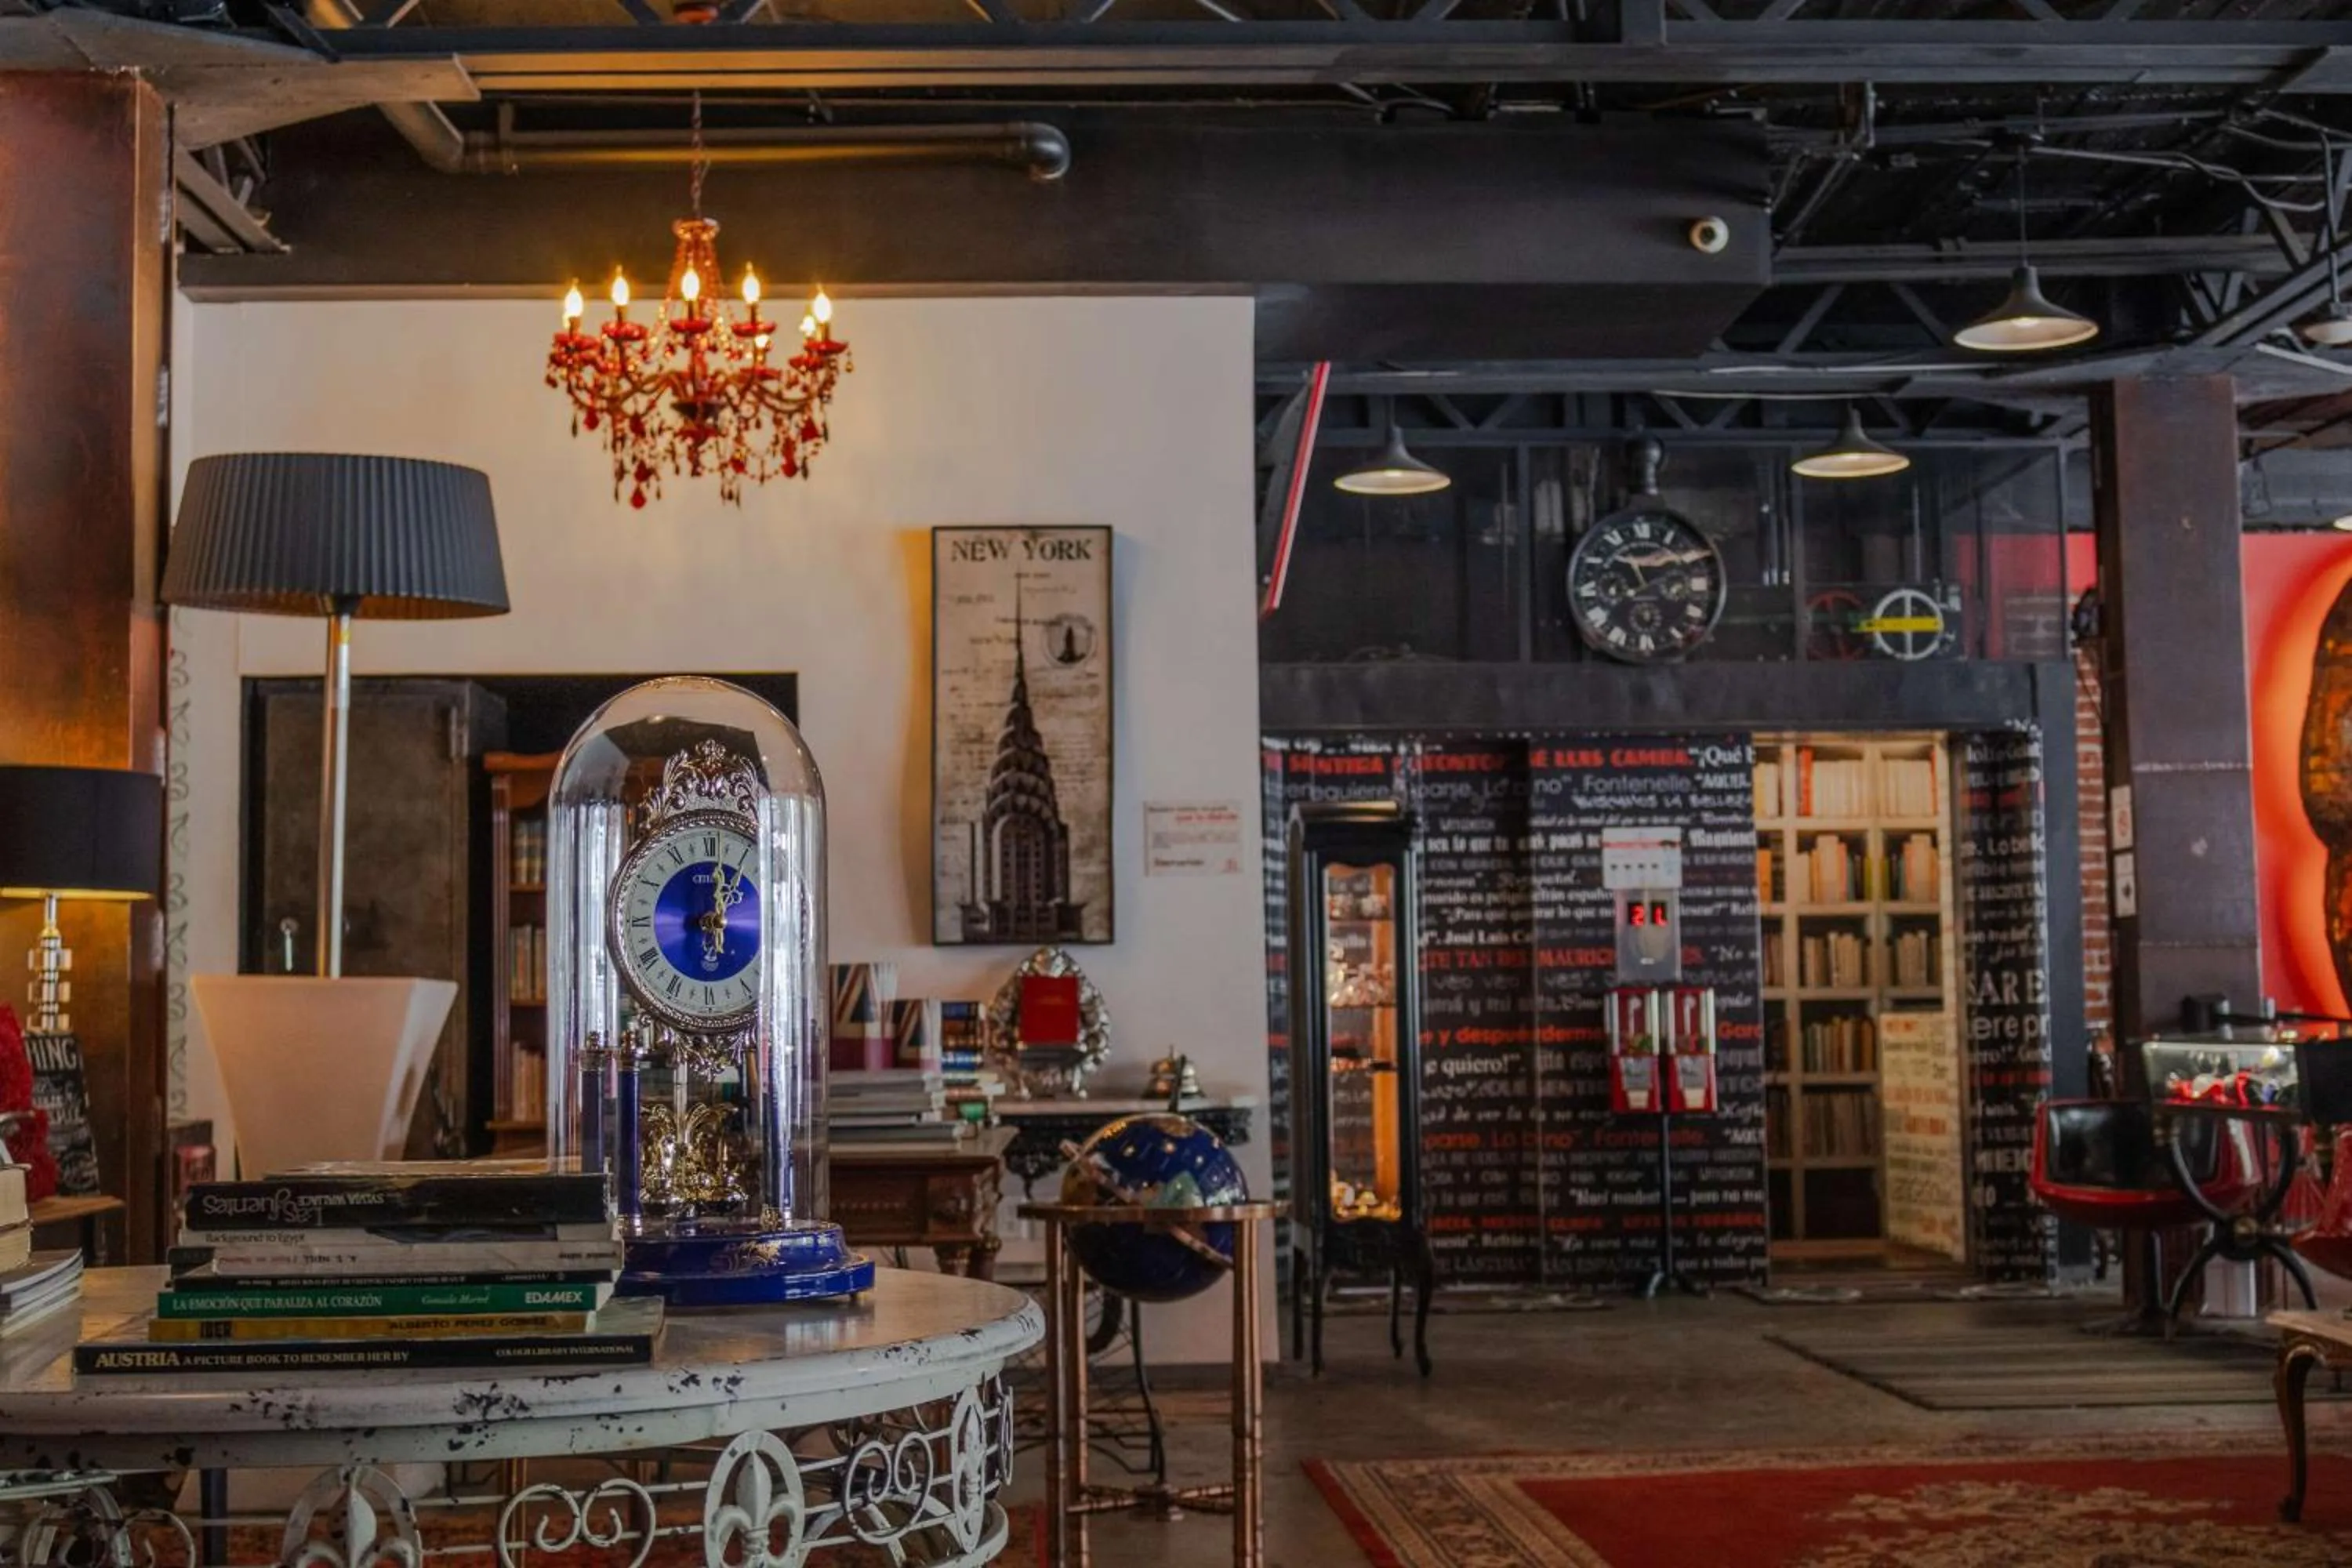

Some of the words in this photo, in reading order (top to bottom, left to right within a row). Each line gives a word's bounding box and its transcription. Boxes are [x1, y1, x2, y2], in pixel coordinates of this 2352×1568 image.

[951, 539, 1011, 562] NEW
[1022, 539, 1091, 561] YORK
[703, 837, 716, 857] XII
[201, 1188, 292, 1222] fuentes
[172, 1297, 187, 1310] LA
[188, 1295, 240, 1310] EMOCIÓN
[241, 1297, 262, 1312] QUE
[264, 1296, 314, 1310] PARALIZA
[316, 1296, 328, 1308] AL
[330, 1294, 383, 1308] CORAZÓN
[524, 1290, 583, 1305] EDAMEX
[95, 1351, 180, 1368] AUSTRIA
[183, 1357, 192, 1367] A
[193, 1356, 243, 1366] PICTURE
[246, 1354, 280, 1365] BOOK
[282, 1353, 299, 1364] TO
[301, 1352, 365, 1363] REMEMBER
[367, 1351, 392, 1363] HER
[394, 1351, 410, 1363] BY
